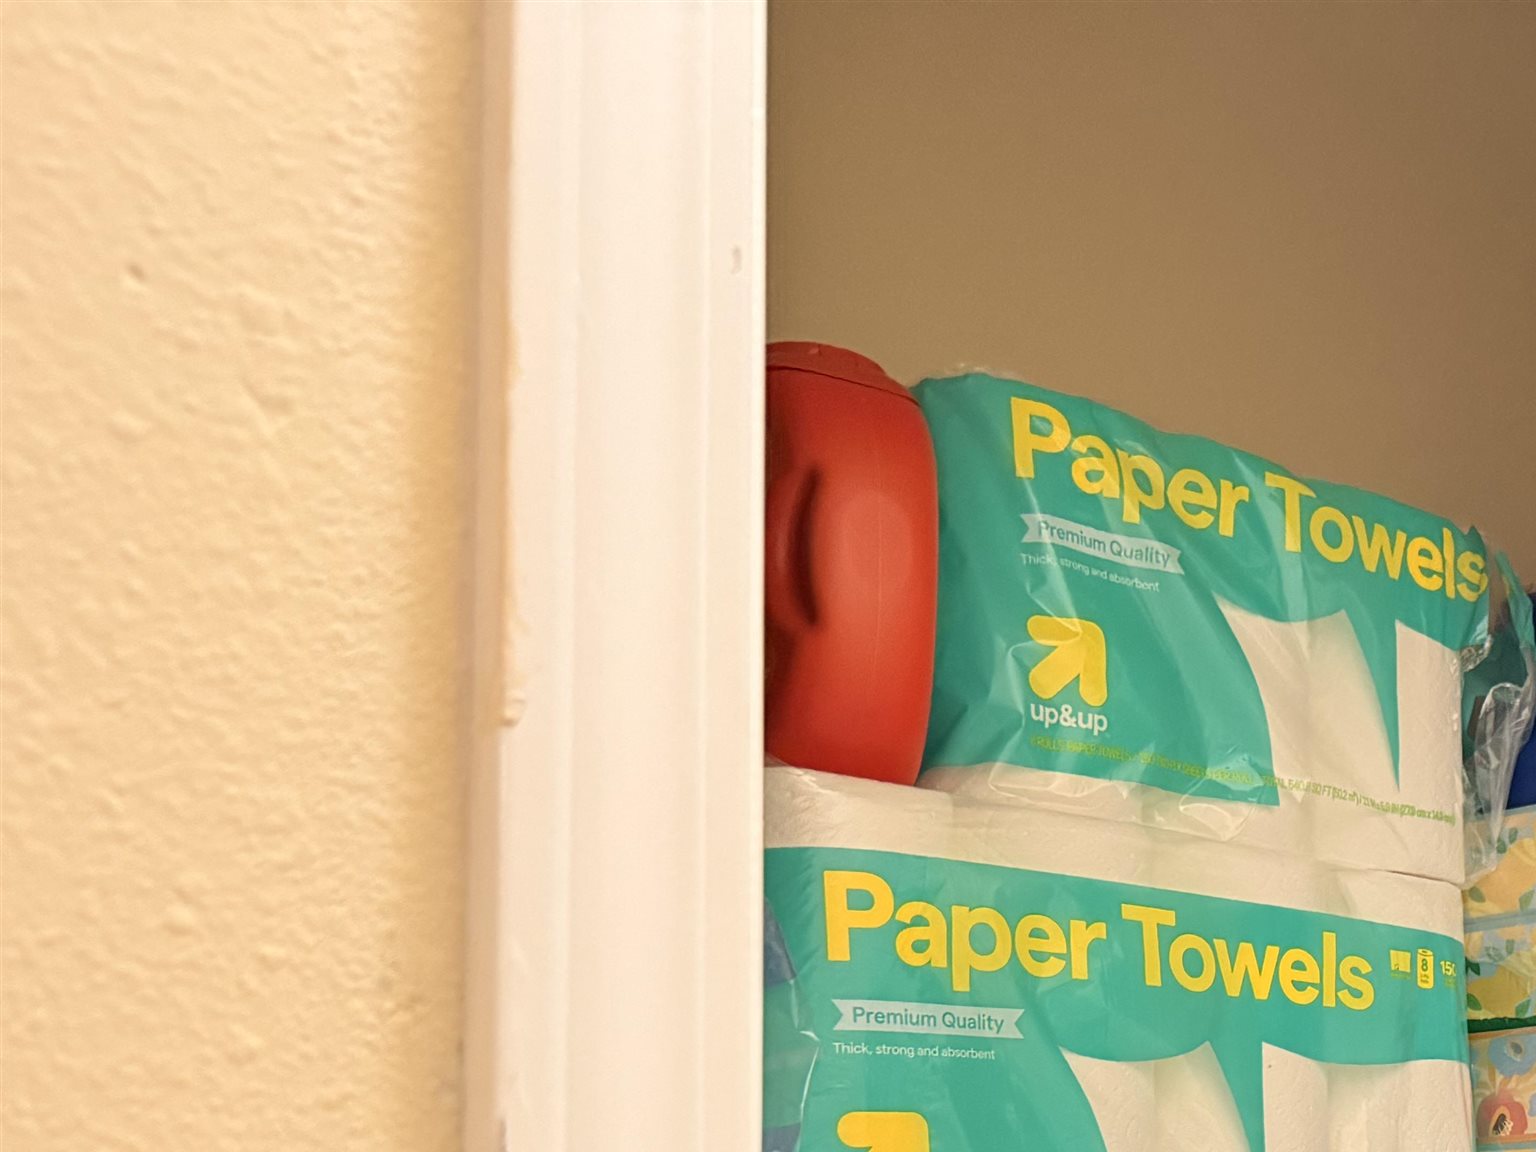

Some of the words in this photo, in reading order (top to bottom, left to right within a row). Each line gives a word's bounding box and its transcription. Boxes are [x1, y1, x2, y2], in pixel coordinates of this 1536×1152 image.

[1010, 397, 1249, 537] Paper
[1265, 471, 1489, 601] Towels
[1038, 520, 1106, 552] Premium
[1110, 540, 1170, 568] Quality
[1060, 557, 1090, 576] strong
[1091, 568, 1108, 580] and
[1109, 573, 1160, 592] absorbent
[1030, 702, 1108, 736] up&up
[824, 871, 1106, 991] Paper
[1121, 903, 1375, 1011] Towels
[852, 1006, 937, 1028] Premium
[942, 1012, 1005, 1034] Quality
[833, 1042, 873, 1055] Thick,
[875, 1044, 915, 1058] strong
[917, 1046, 939, 1057] and
[941, 1047, 996, 1060] absorbent
